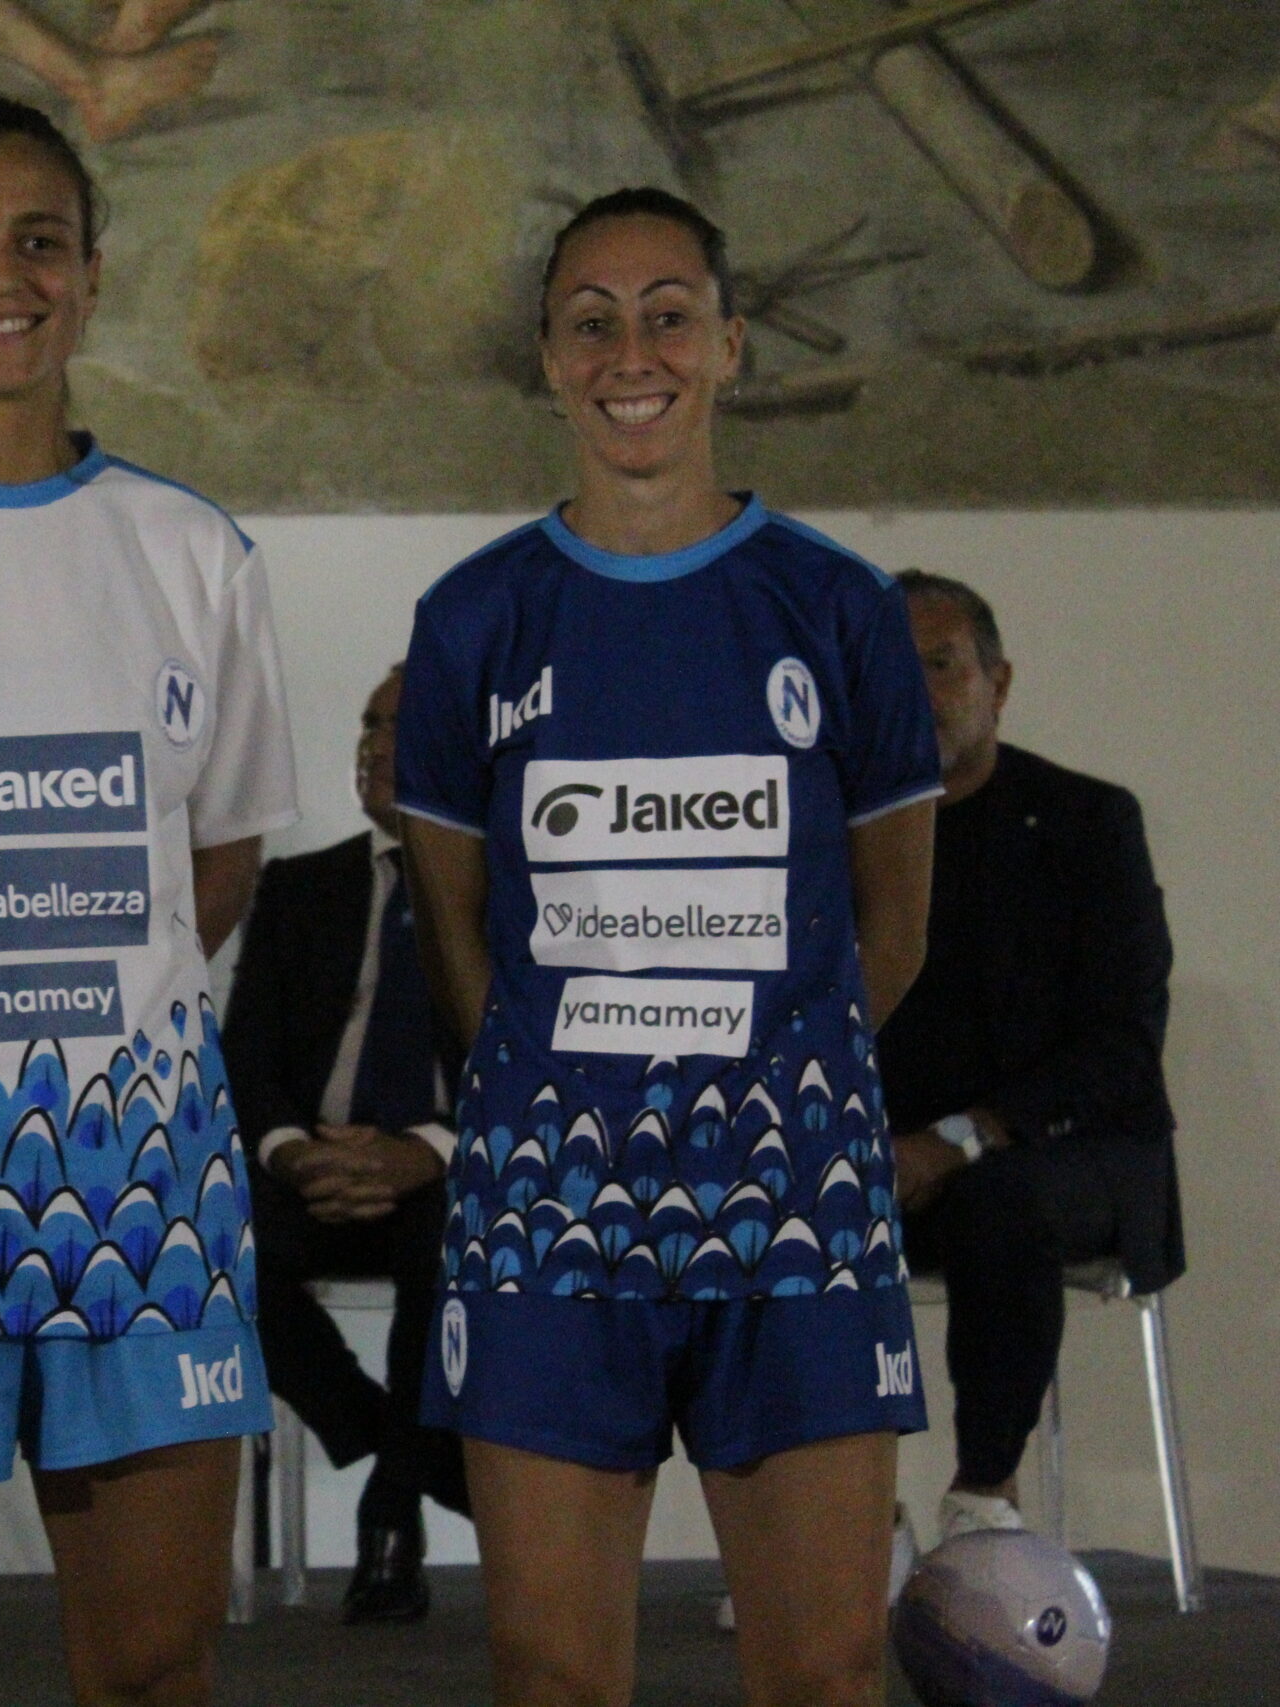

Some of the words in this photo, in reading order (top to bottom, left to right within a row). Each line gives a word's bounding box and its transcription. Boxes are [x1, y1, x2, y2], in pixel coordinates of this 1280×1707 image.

[164, 674, 194, 732] N
[781, 674, 810, 729] N
[610, 779, 778, 833] Jaked
[575, 904, 781, 938] ideabellezza
[563, 1001, 746, 1034] yamamay
[177, 1343, 244, 1410] Jkd
